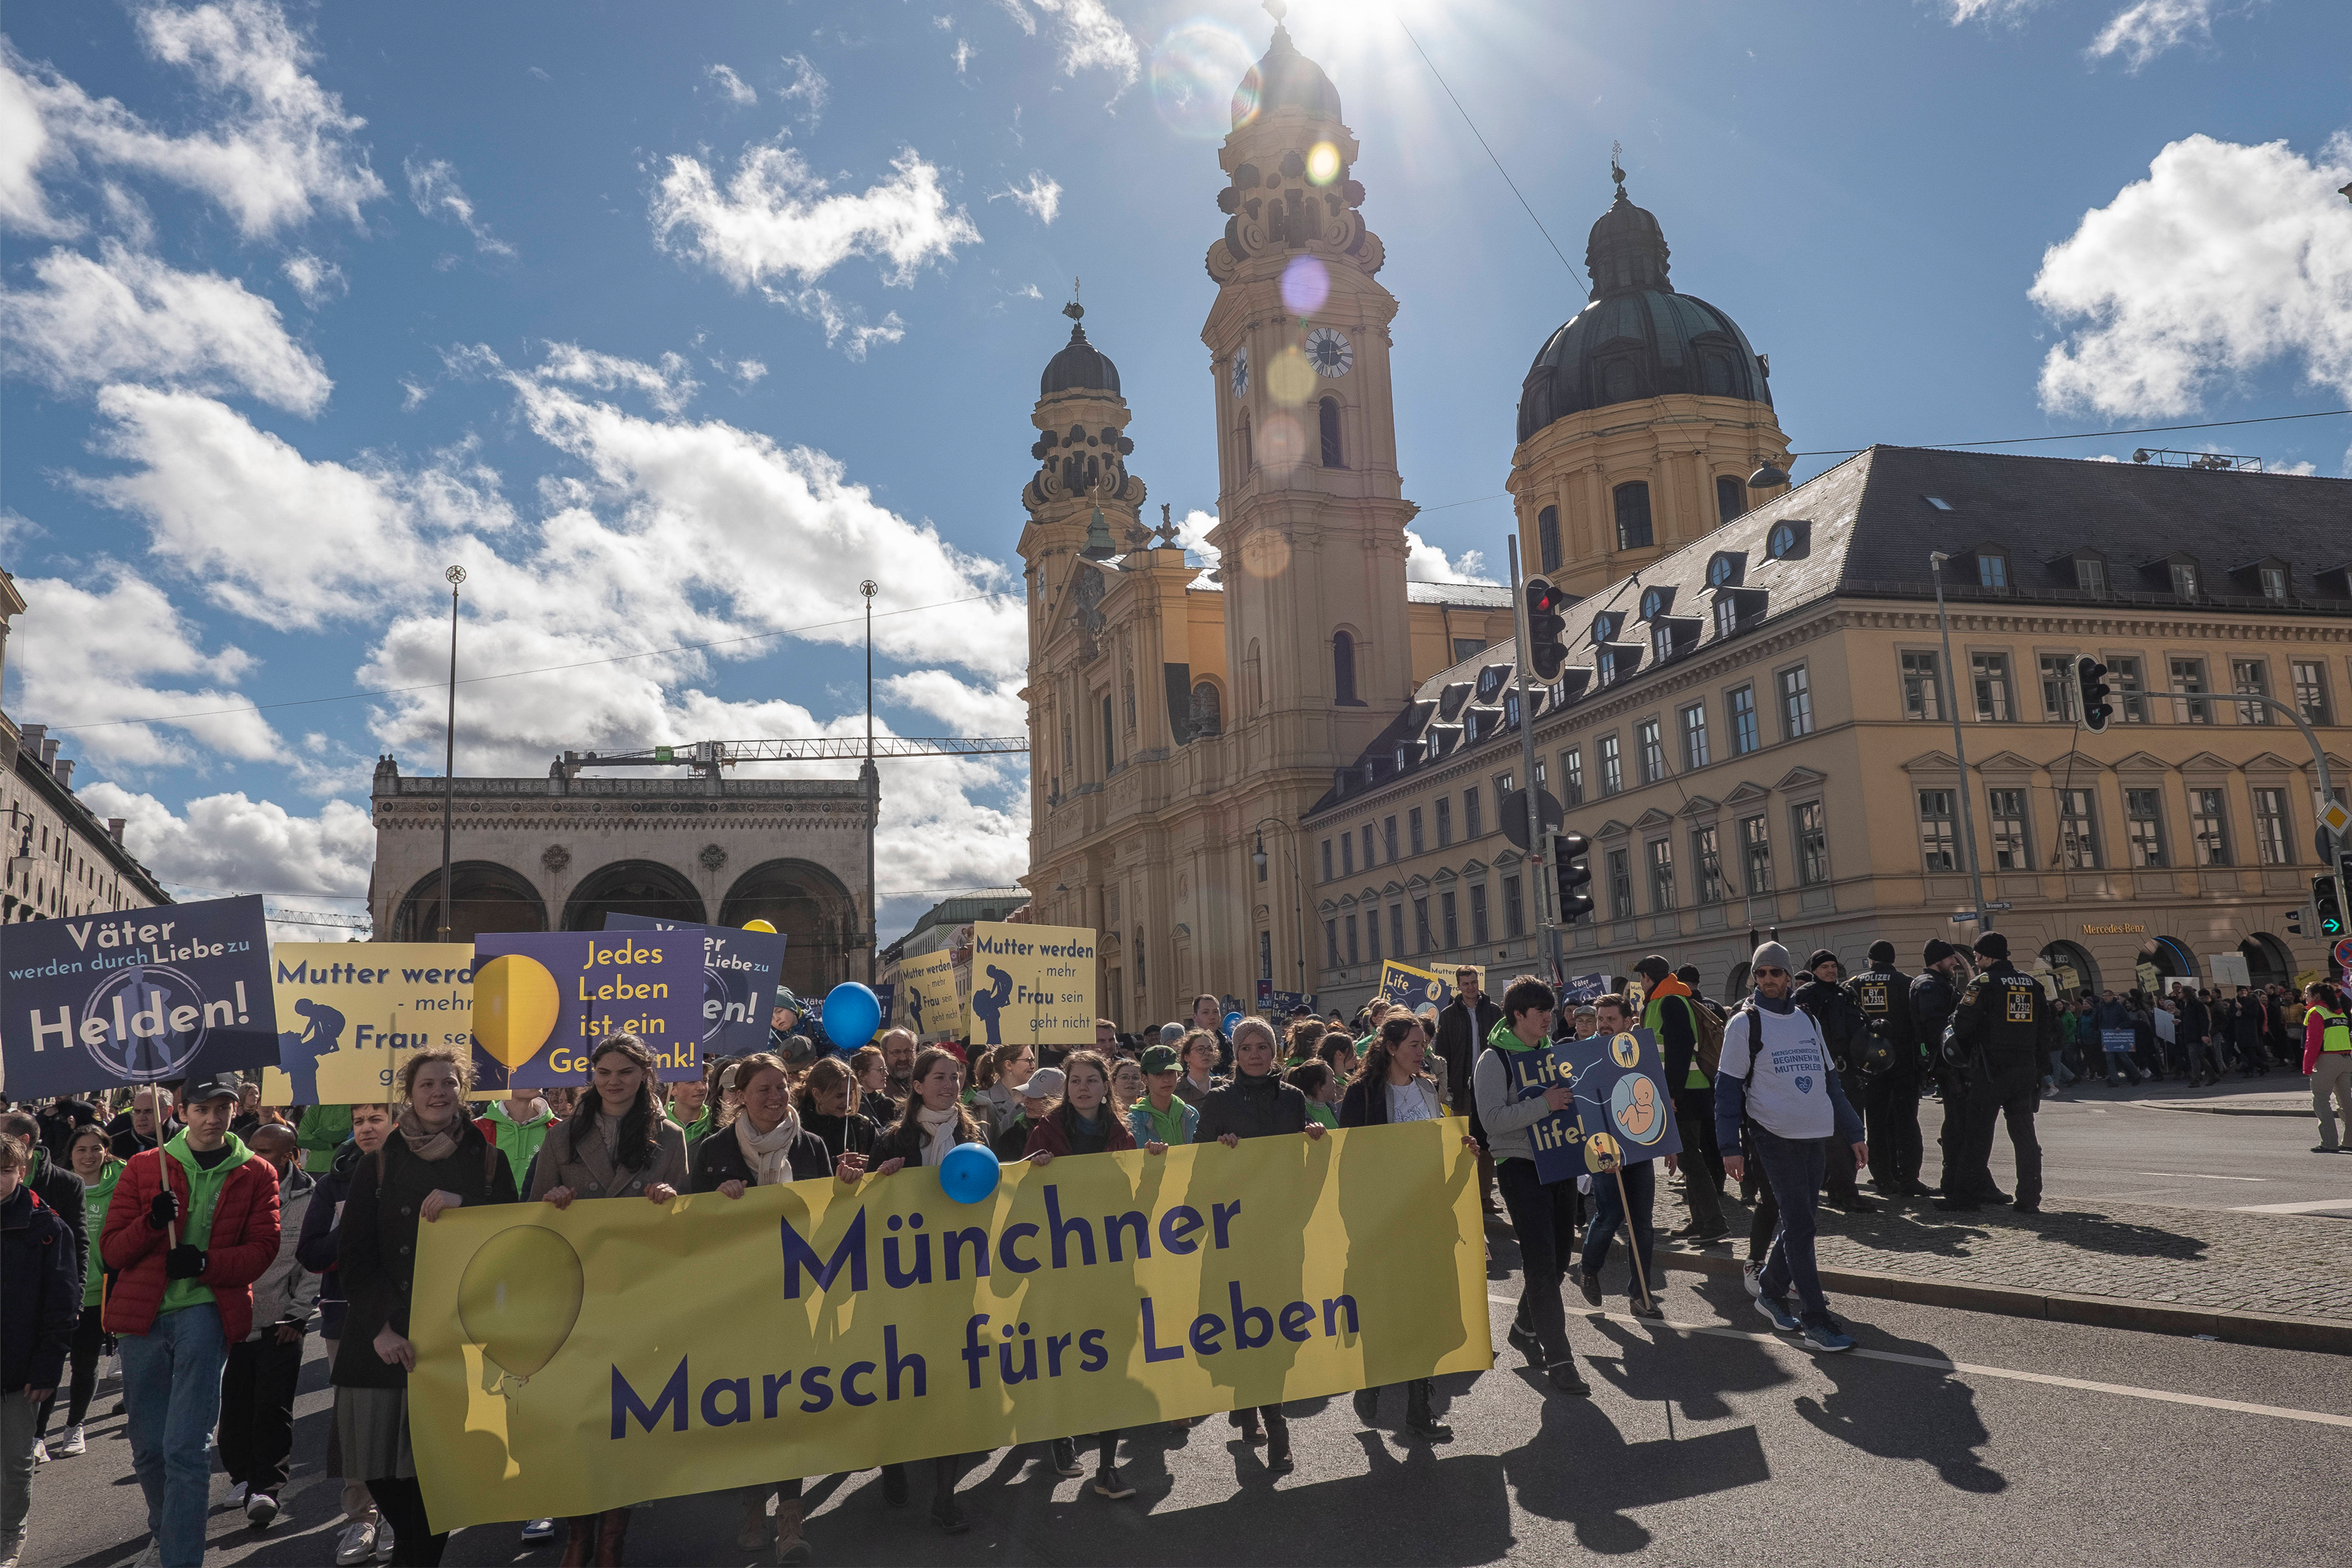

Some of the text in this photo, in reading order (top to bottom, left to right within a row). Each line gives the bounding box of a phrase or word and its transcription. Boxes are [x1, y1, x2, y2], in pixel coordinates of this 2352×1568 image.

[65, 920, 176, 952] Väter
[2082, 923, 2145, 935] Mercedes-Benz
[583, 938, 663, 970] Jedes
[976, 934, 1094, 959] Mutter werden
[9, 938, 250, 981] werden durch Liebe zu
[704, 952, 769, 973] Liebe zu
[902, 958, 952, 981] Mutter werden
[277, 959, 390, 985] Mutter
[1047, 962, 1076, 978] mehr
[1859, 974, 1891, 982] POLIZEI
[579, 974, 668, 1001] Leben
[931, 975, 946, 989] mehr
[1386, 971, 1409, 990] Life
[1573, 979, 1589, 988] Väter
[2001, 977, 2034, 986] POLIZEI
[923, 994, 953, 1009] Frau sein
[1018, 985, 1083, 1005] Frau sein
[1273, 993, 1290, 1002] Life
[1382, 989, 1392, 1002] is
[2015, 994, 2025, 1003] BY
[30, 980, 249, 1052] Helden!
[931, 1009, 958, 1025] geht nicht
[1272, 1010, 1287, 1018] life!
[2009, 1003, 2031, 1011] M 7312
[580, 1013, 665, 1036] ist ein
[1029, 1012, 1090, 1032] geht nicht
[355, 1024, 428, 1050] Frau
[549, 1042, 695, 1073] Genk!
[1771, 1048, 1819, 1058] MENSCHENRECHTE
[1773, 1054, 1813, 1065] BEGINNEN
[1518, 1053, 1573, 1087] Life
[1774, 1063, 1822, 1074] MUTTERLEIB
[1532, 1114, 1587, 1151] life!
[780, 1184, 1241, 1300] Münchner
[610, 1280, 1360, 1440] Marsch fürs Leben
